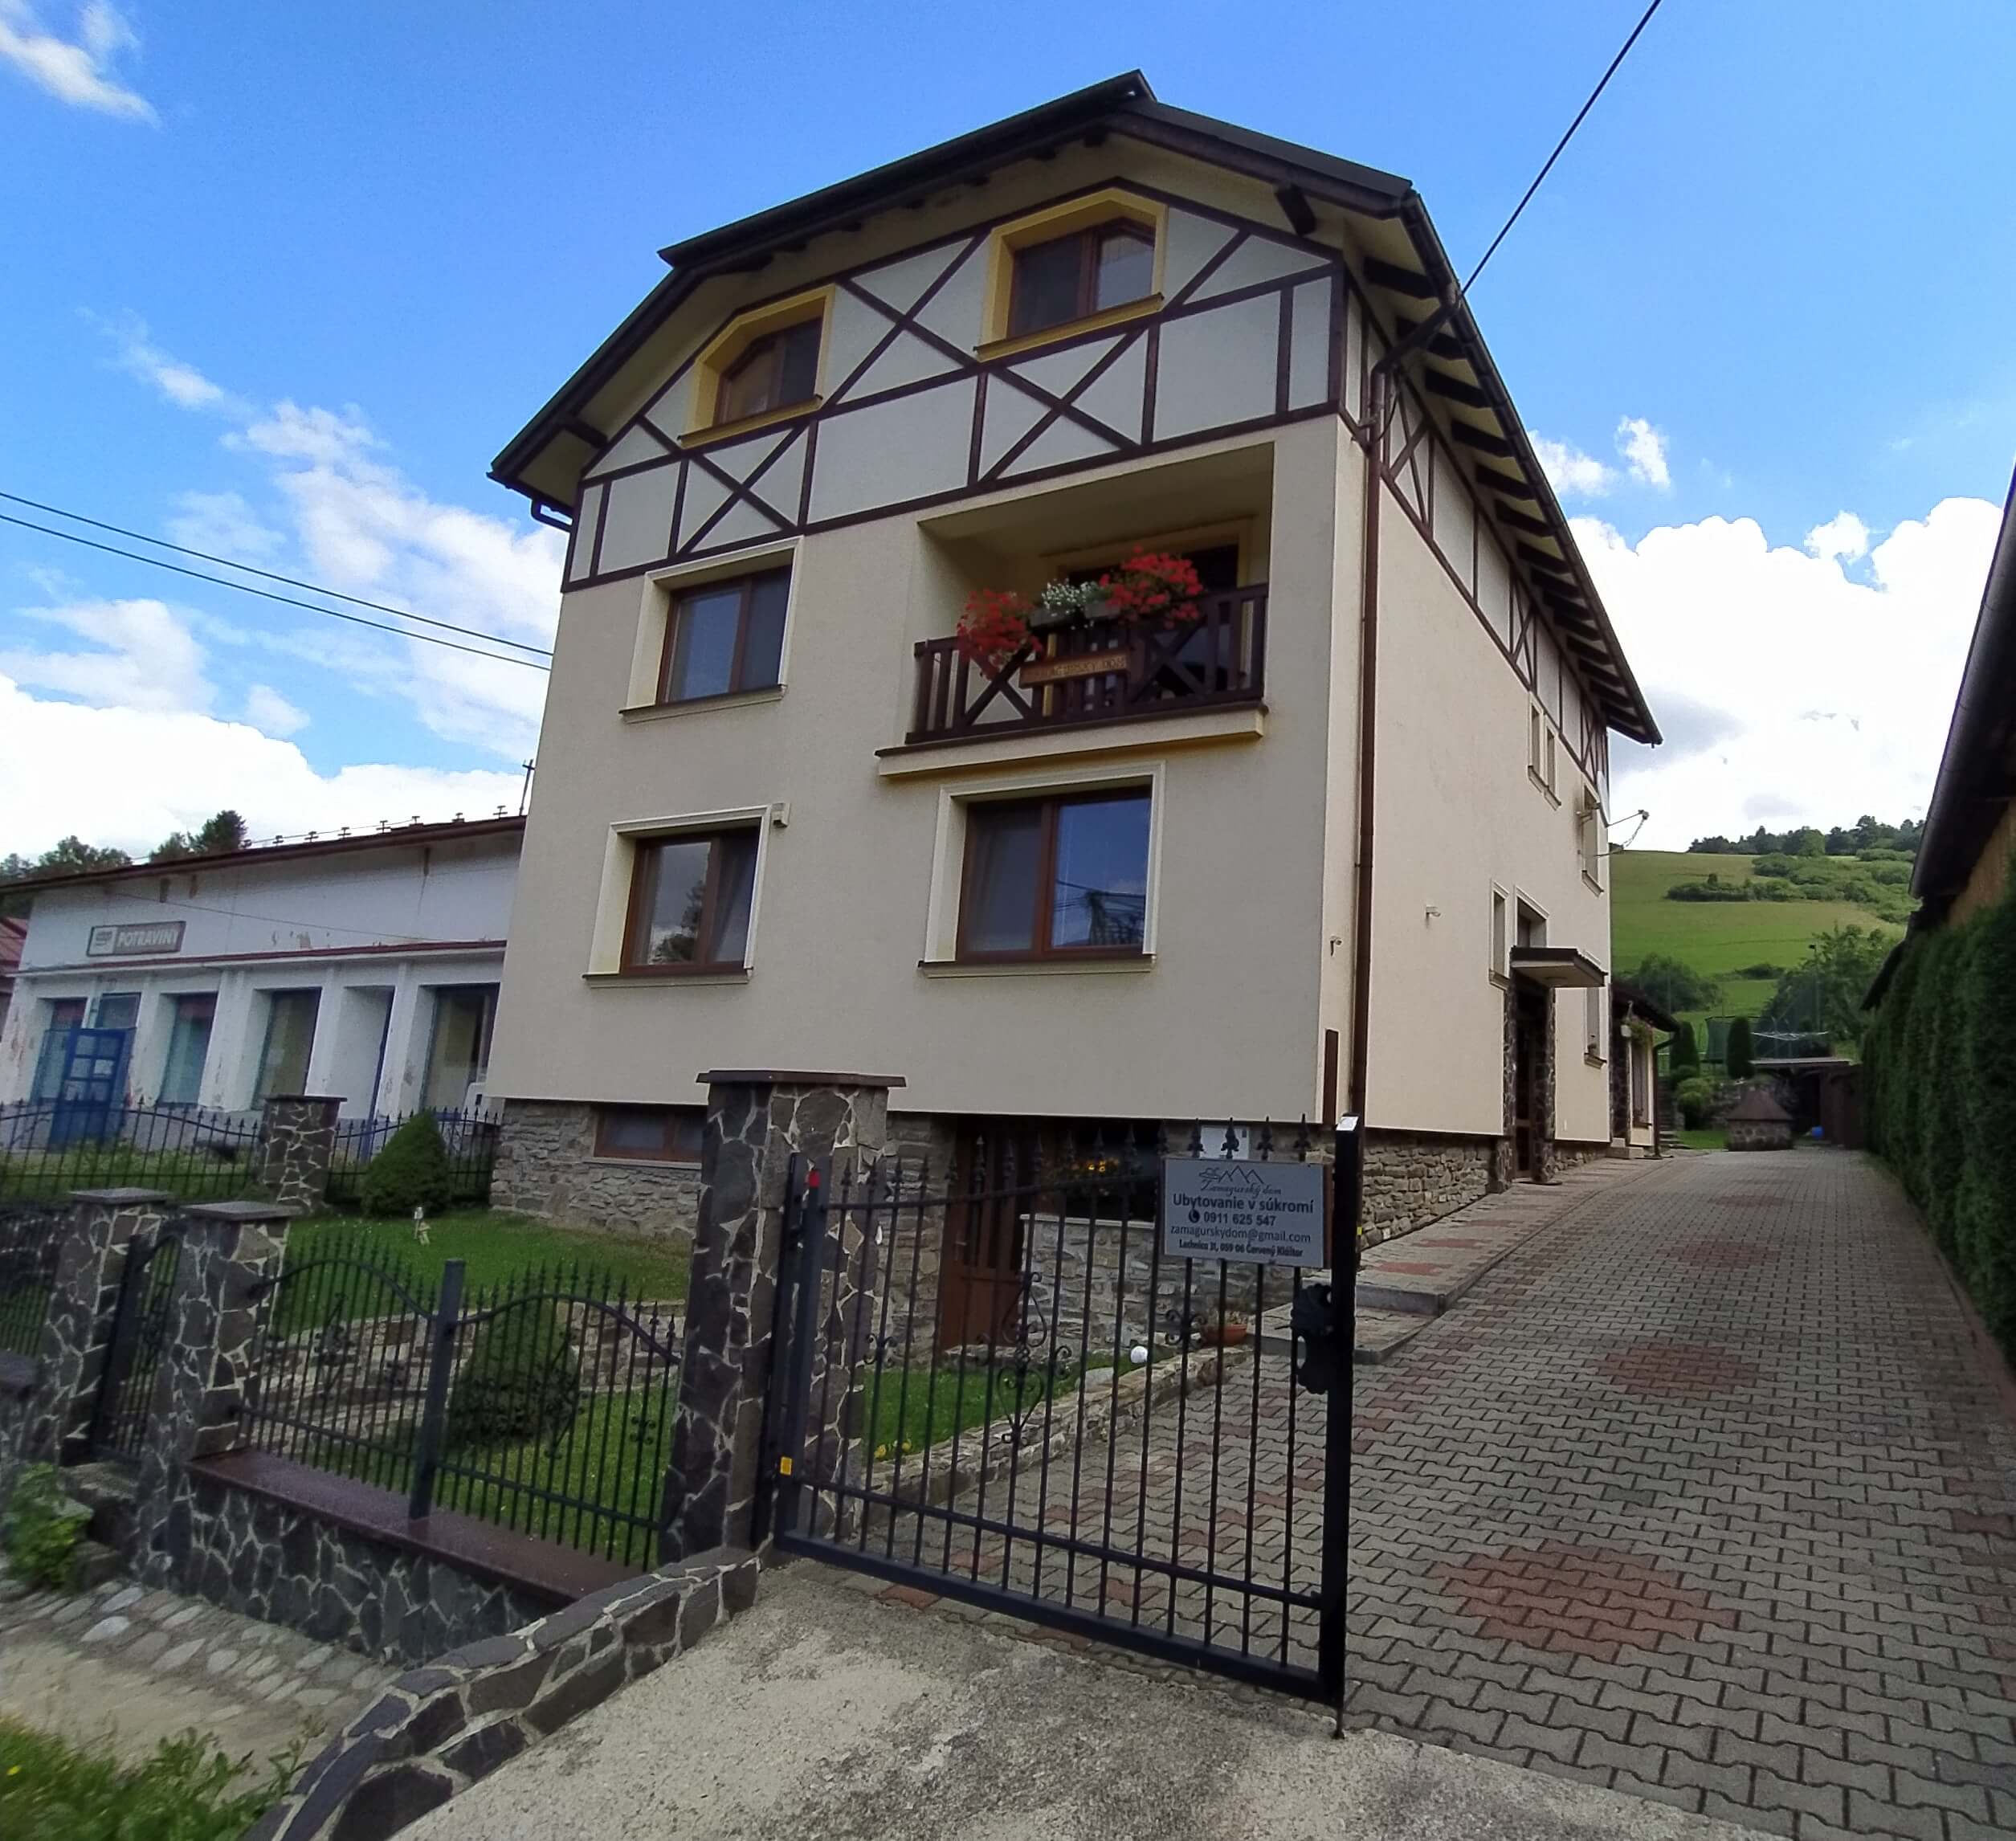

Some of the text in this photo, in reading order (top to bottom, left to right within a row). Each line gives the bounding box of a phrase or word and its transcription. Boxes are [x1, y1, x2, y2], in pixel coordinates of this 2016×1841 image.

[117, 930, 179, 946] POTRAVINY
[1173, 1194, 1313, 1214] Ubytovanie v súkromí
[1204, 1211, 1276, 1227] 0911 625 547
